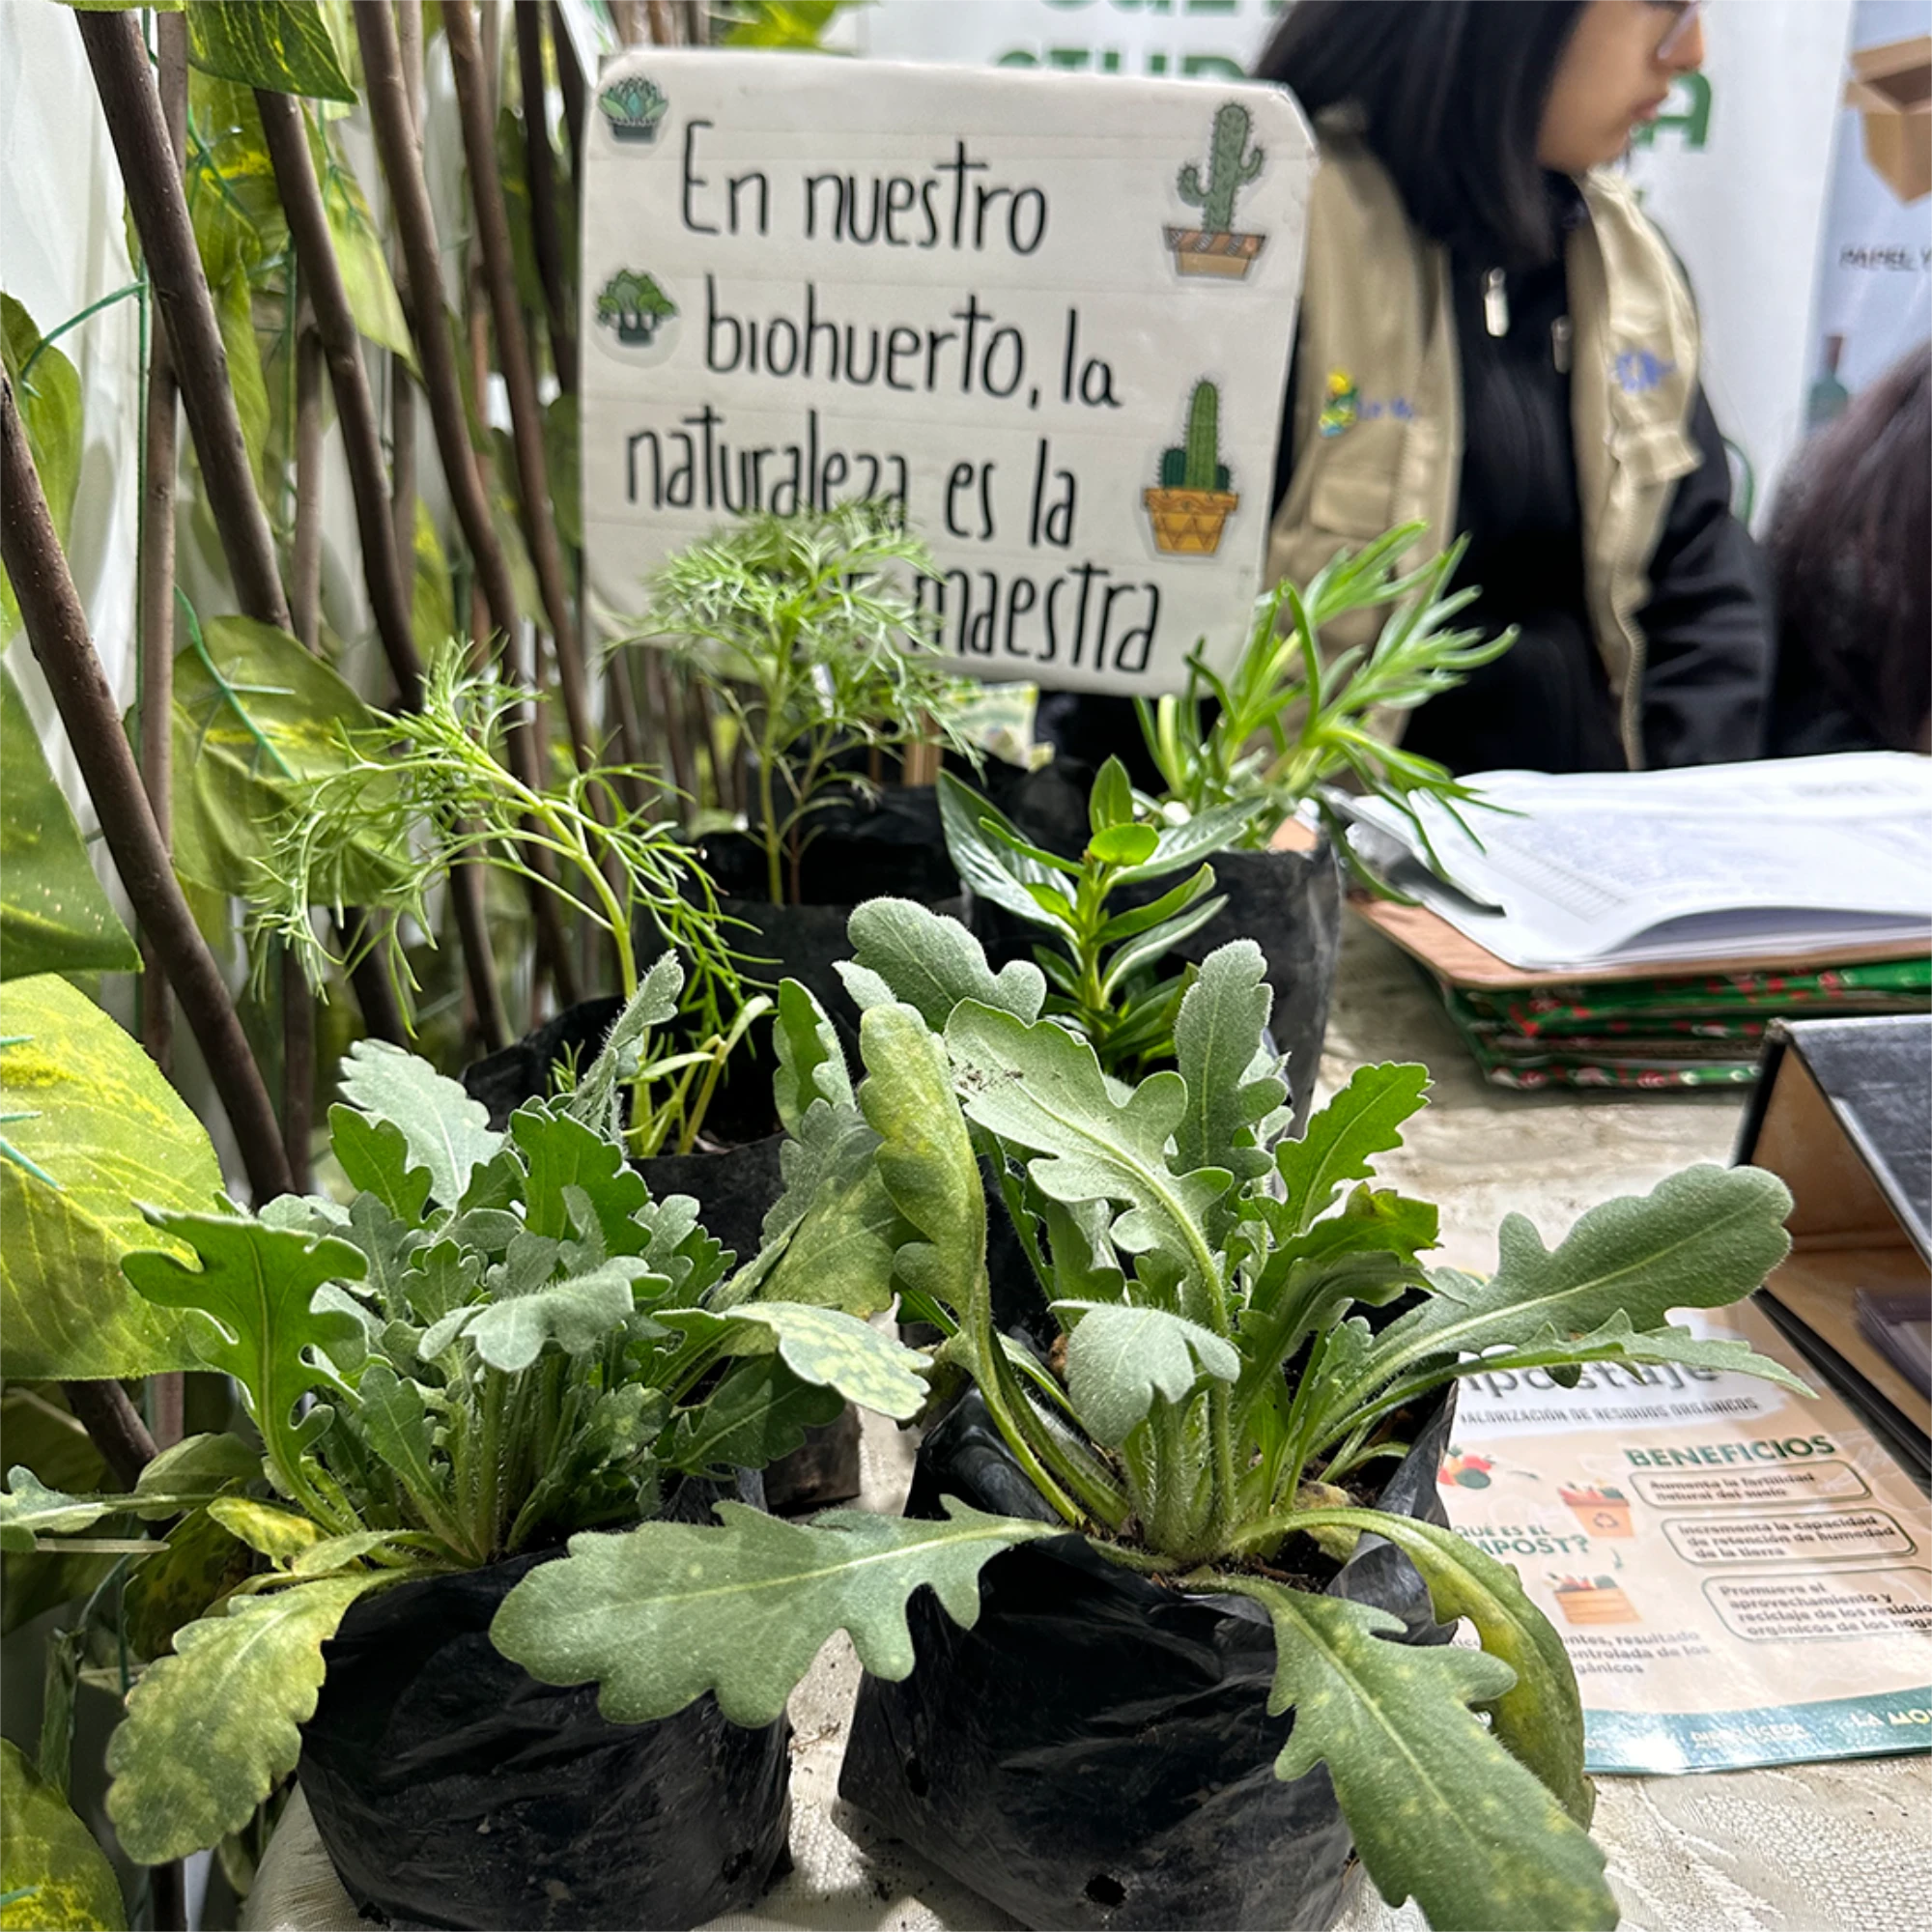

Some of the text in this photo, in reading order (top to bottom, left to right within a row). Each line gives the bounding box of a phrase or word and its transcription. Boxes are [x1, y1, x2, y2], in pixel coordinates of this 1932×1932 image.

[680, 119, 1048, 254] En nuestro
[705, 273, 1122, 409] biohuerto, la
[945, 460, 994, 540] es
[1030, 438, 1077, 547] la
[911, 561, 1161, 673] maestra
[1624, 1435, 1835, 1467] BENEFICIOS
[1500, 1525, 1523, 1537] ES
[1879, 1593, 1892, 1605] y
[1614, 1630, 1701, 1646] resultado
